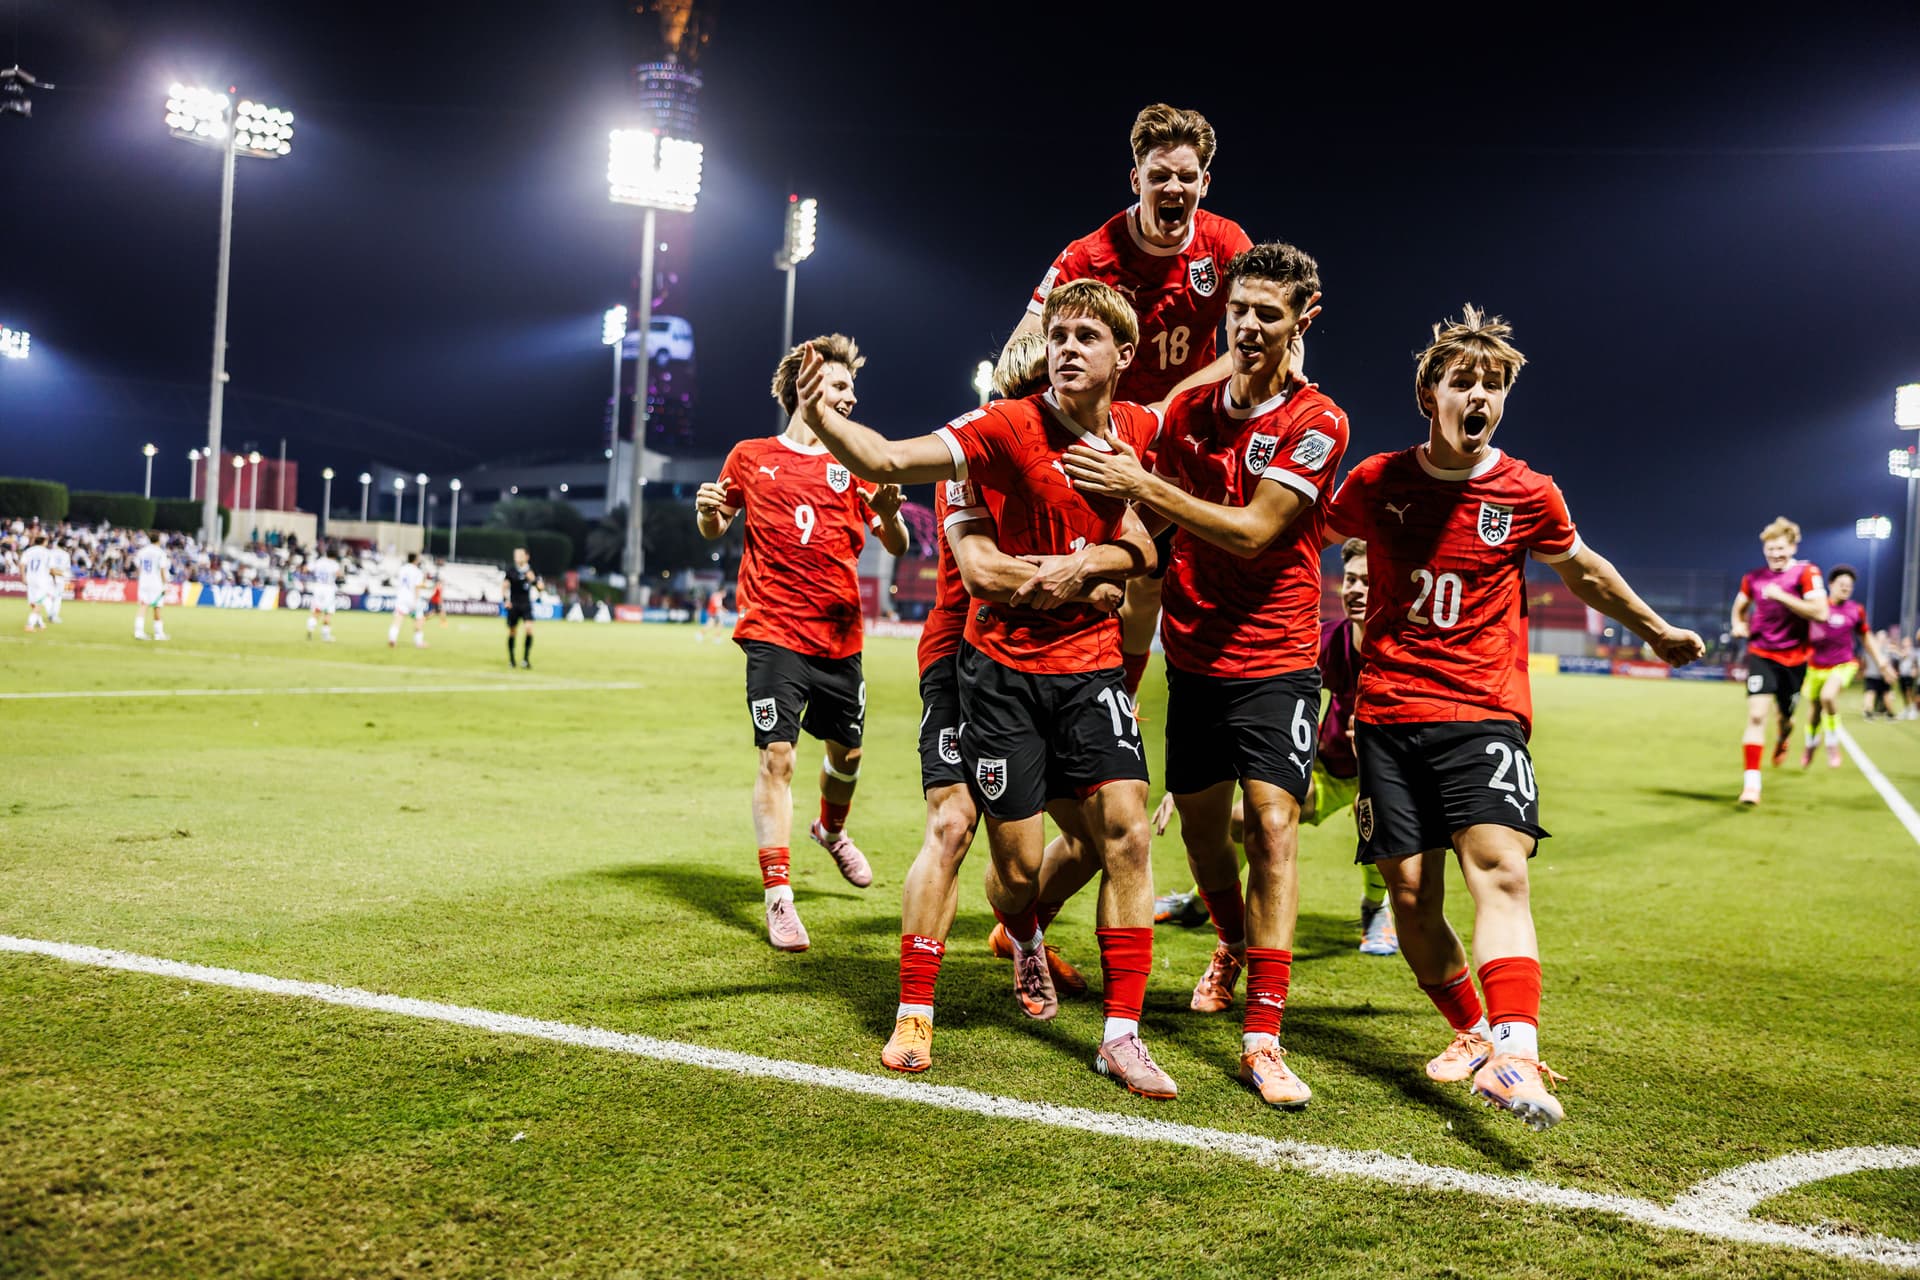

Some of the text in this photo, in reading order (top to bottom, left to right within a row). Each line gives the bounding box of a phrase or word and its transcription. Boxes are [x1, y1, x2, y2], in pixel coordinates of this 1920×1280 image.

[1151, 325, 1190, 370] 18
[794, 504, 815, 545] 9
[212, 585, 253, 608] VISA
[1407, 569, 1462, 628] 20
[1097, 687, 1138, 736] 19
[1291, 699, 1311, 752] 6
[1485, 742, 1535, 802] 20
